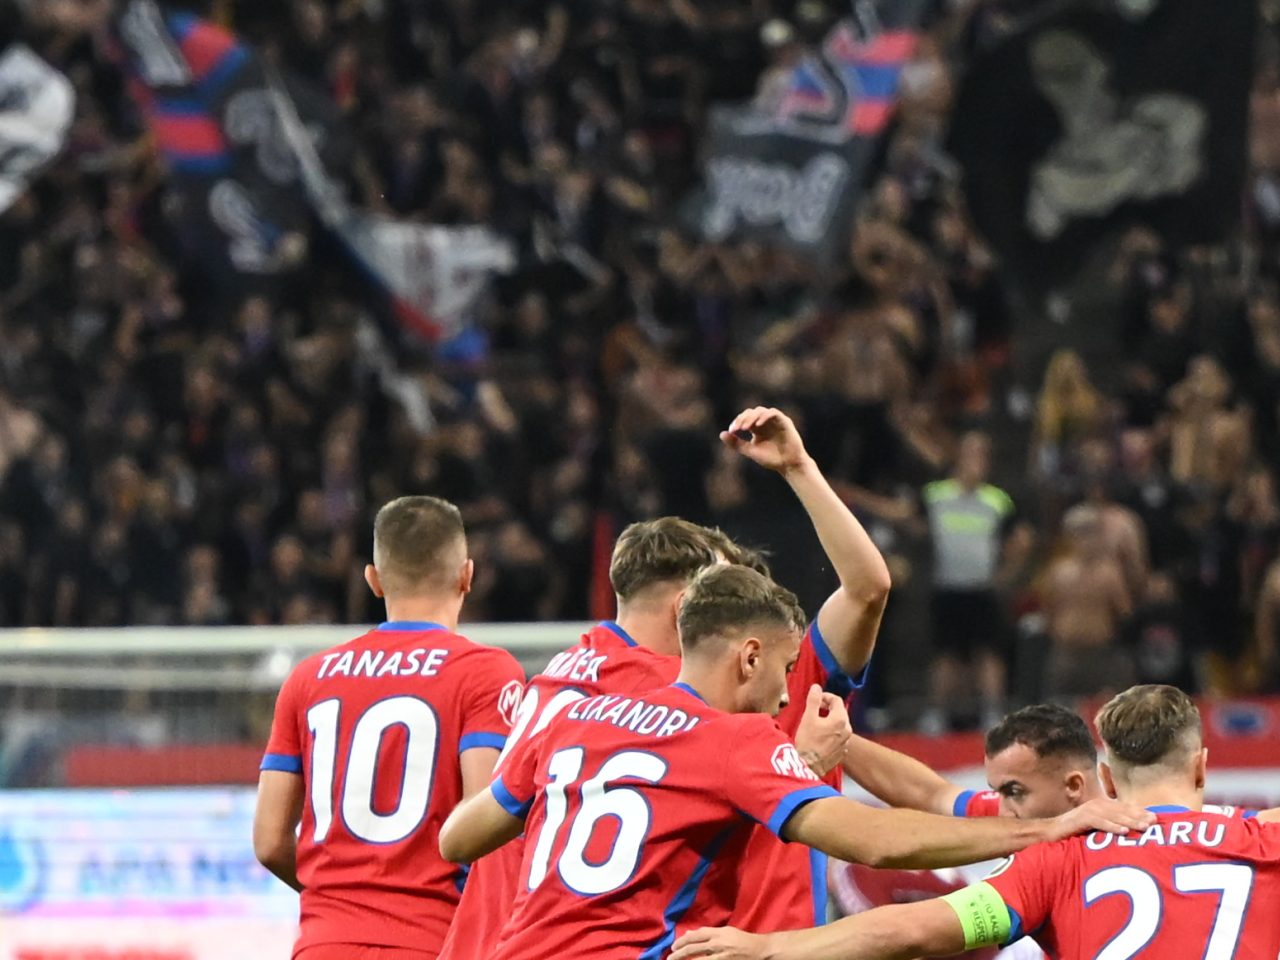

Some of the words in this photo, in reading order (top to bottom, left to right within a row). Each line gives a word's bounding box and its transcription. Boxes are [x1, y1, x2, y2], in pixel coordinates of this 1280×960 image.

[317, 648, 449, 680] TANASE
[306, 694, 440, 845] 10
[527, 745, 669, 897] 16
